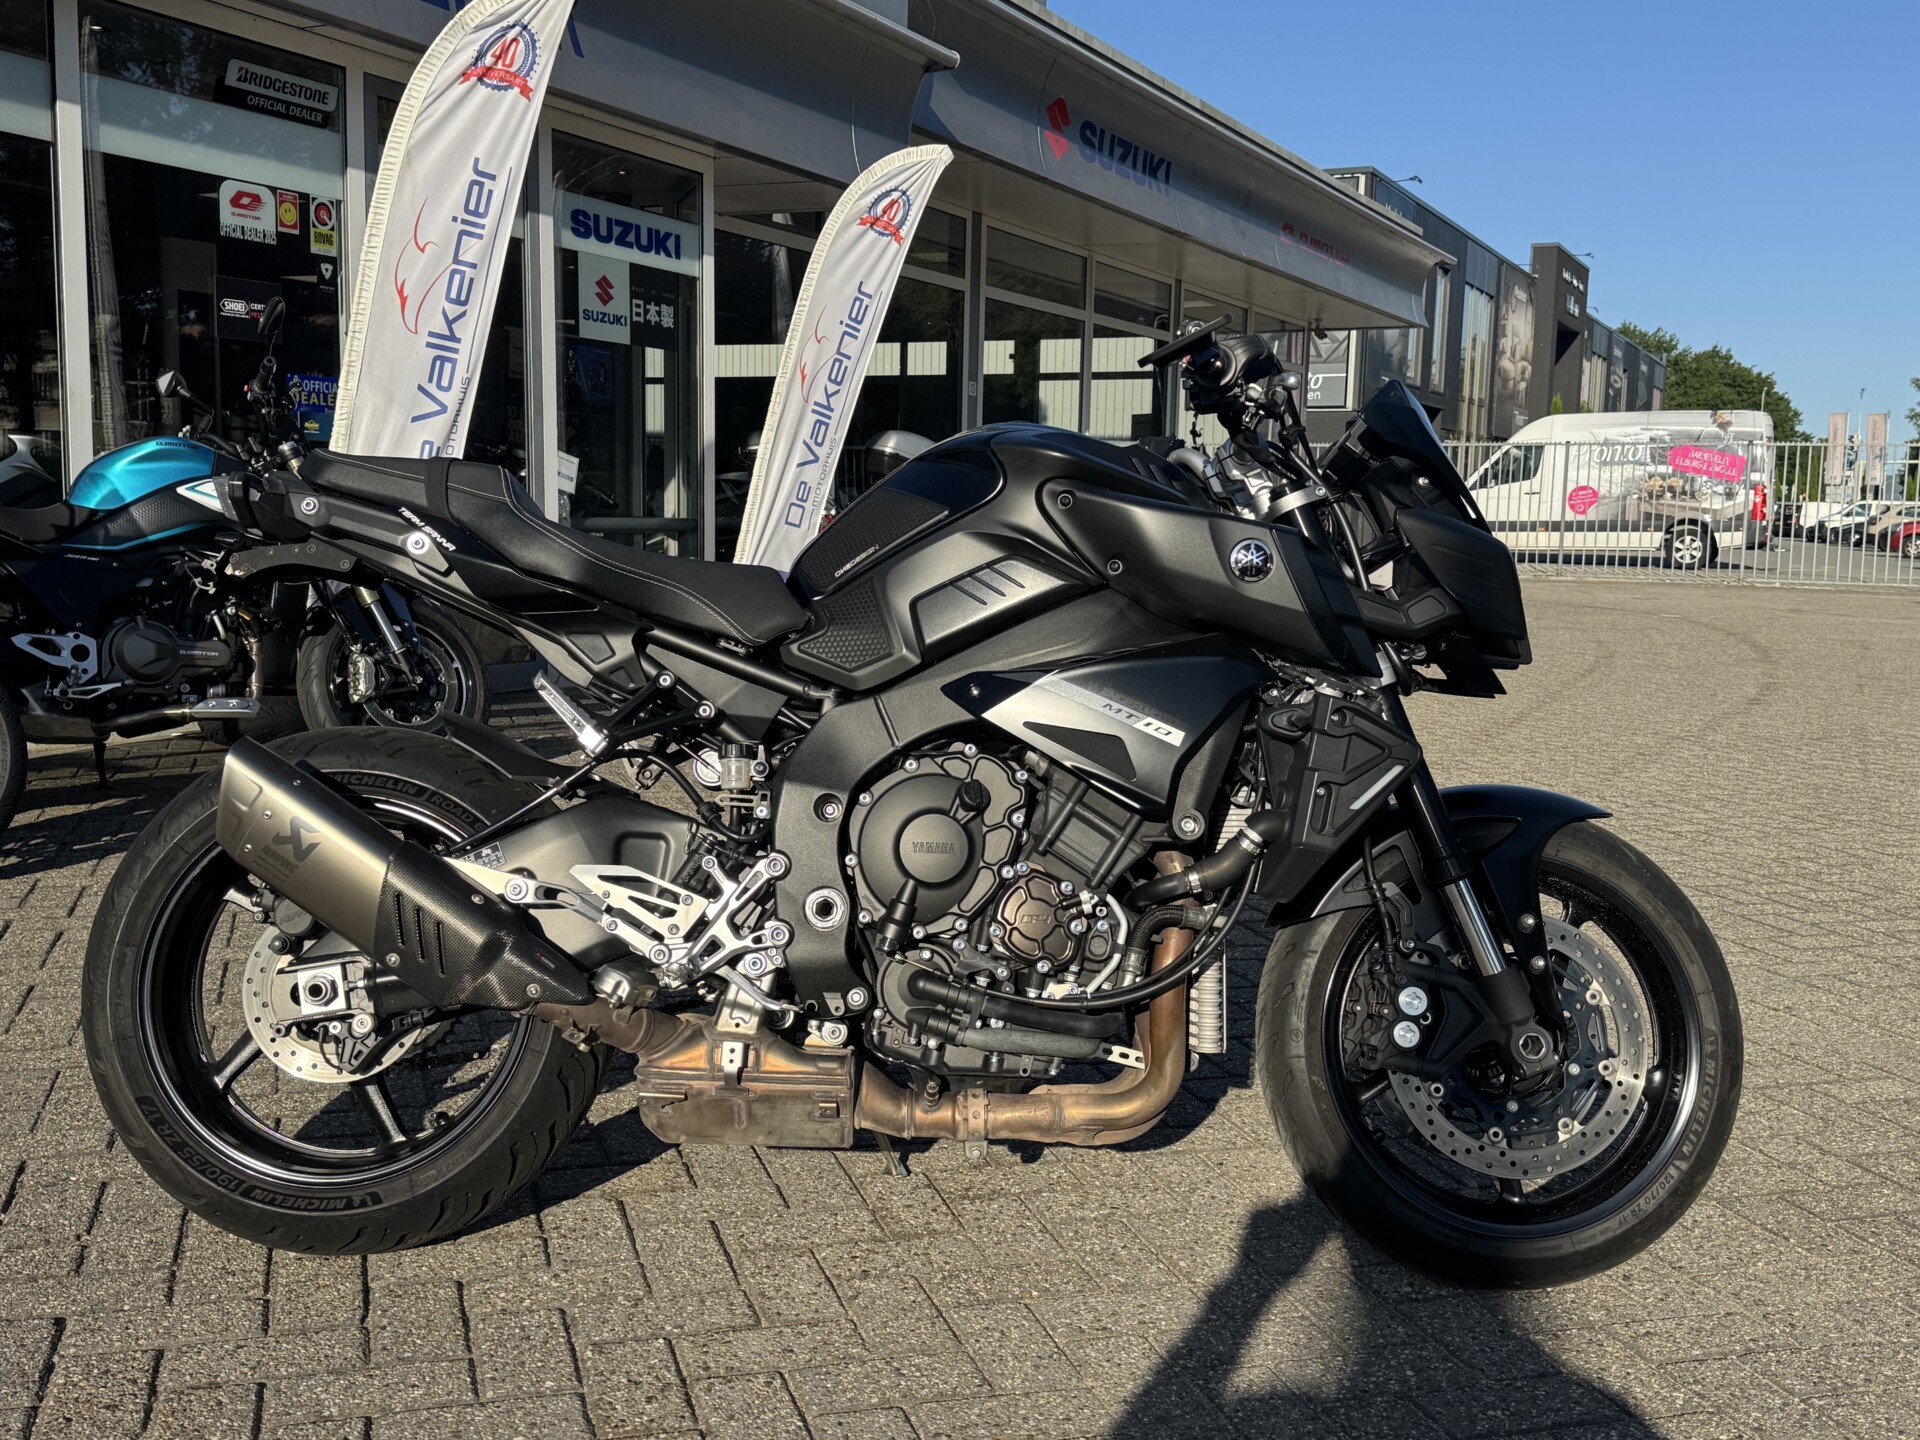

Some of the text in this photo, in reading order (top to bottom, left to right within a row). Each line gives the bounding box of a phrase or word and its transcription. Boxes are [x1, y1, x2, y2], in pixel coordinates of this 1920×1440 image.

[490, 36, 521, 69] 40
[235, 66, 330, 106] BRIDGESTONE
[473, 67, 526, 87] ANNIVERSARY
[247, 95, 323, 123] OFFICIAL DEALER
[1079, 119, 1173, 197] SUZUKI
[220, 221, 243, 240] OFFICIAL
[244, 226, 264, 243] DEALER
[313, 230, 334, 247] BOVAG
[570, 208, 681, 260] SUZUKI
[410, 156, 498, 424] Valkenier
[224, 301, 245, 312] SHOEI
[250, 303, 266, 311] CERT
[582, 308, 628, 327] SUZUKI
[632, 298, 675, 329] 日本製
[294, 391, 335, 406] EALE
[303, 379, 339, 394] OFFICIA
[444, 376, 471, 457] OTORHUIS
[784, 280, 873, 529] De Valkenier
[155, 441, 200, 450] QJMOTOR
[812, 437, 837, 508] MOTORHUIS
[834, 544, 879, 577] ONEDESIGN
[1102, 703, 1172, 736] MT 10
[330, 773, 420, 795] MICHELIN
[431, 794, 474, 823] ROAD
[912, 841, 956, 855] YAMAHA
[1020, 914, 1052, 925] CP4
[140, 1101, 346, 1211] MICHELIN 190/55 ZR 17
[1617, 1058, 1716, 1229] MICHELIN 120/70 ZR 17
